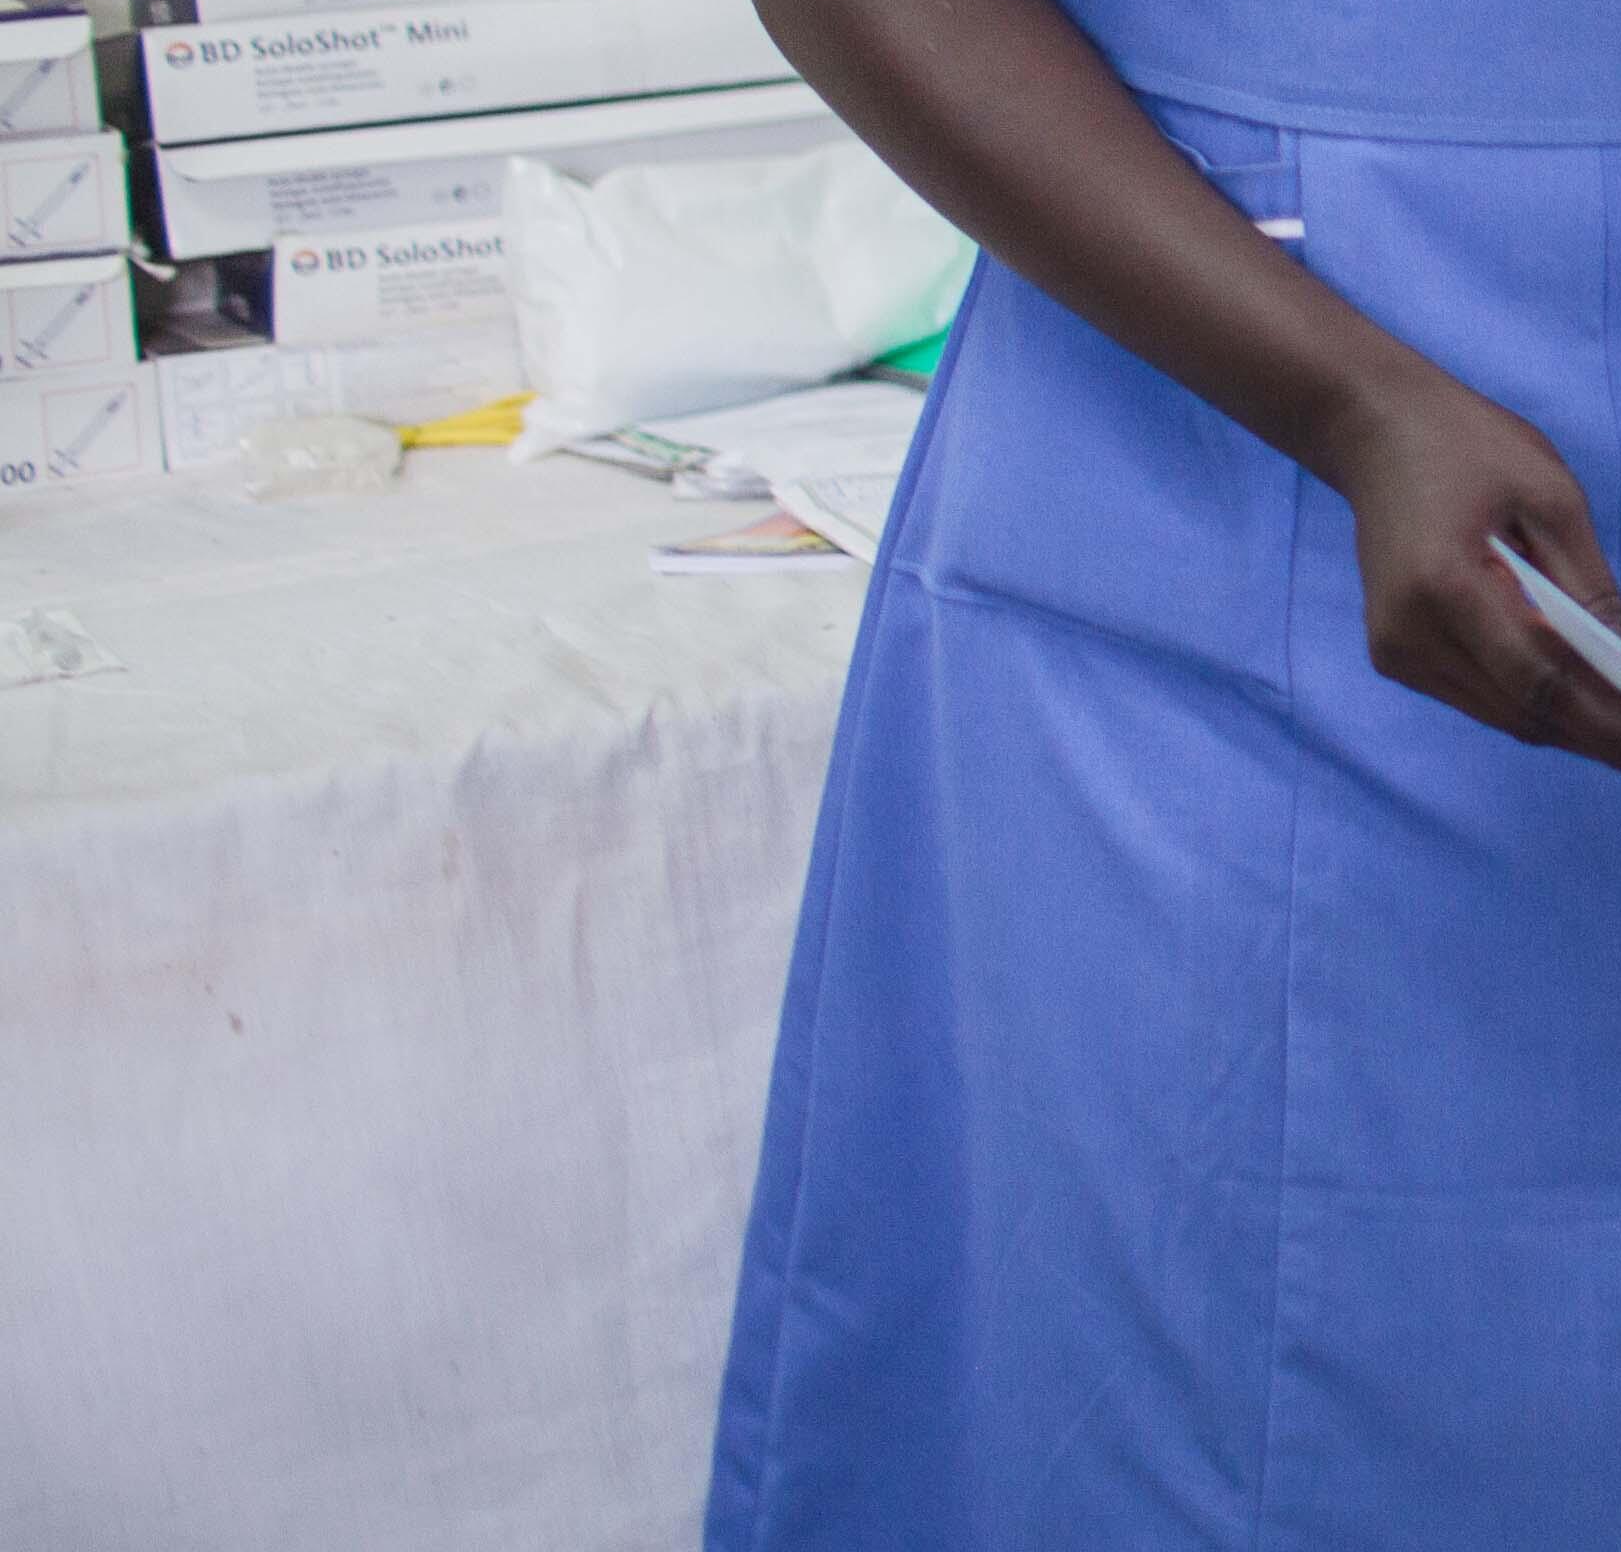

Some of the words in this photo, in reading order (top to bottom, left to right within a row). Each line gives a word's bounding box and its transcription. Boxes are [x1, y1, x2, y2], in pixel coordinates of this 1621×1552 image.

[200, 38, 242, 64] BD
[405, 19, 469, 44] Mini
[326, 245, 367, 271] BD
[375, 236, 507, 265] SoloShot
